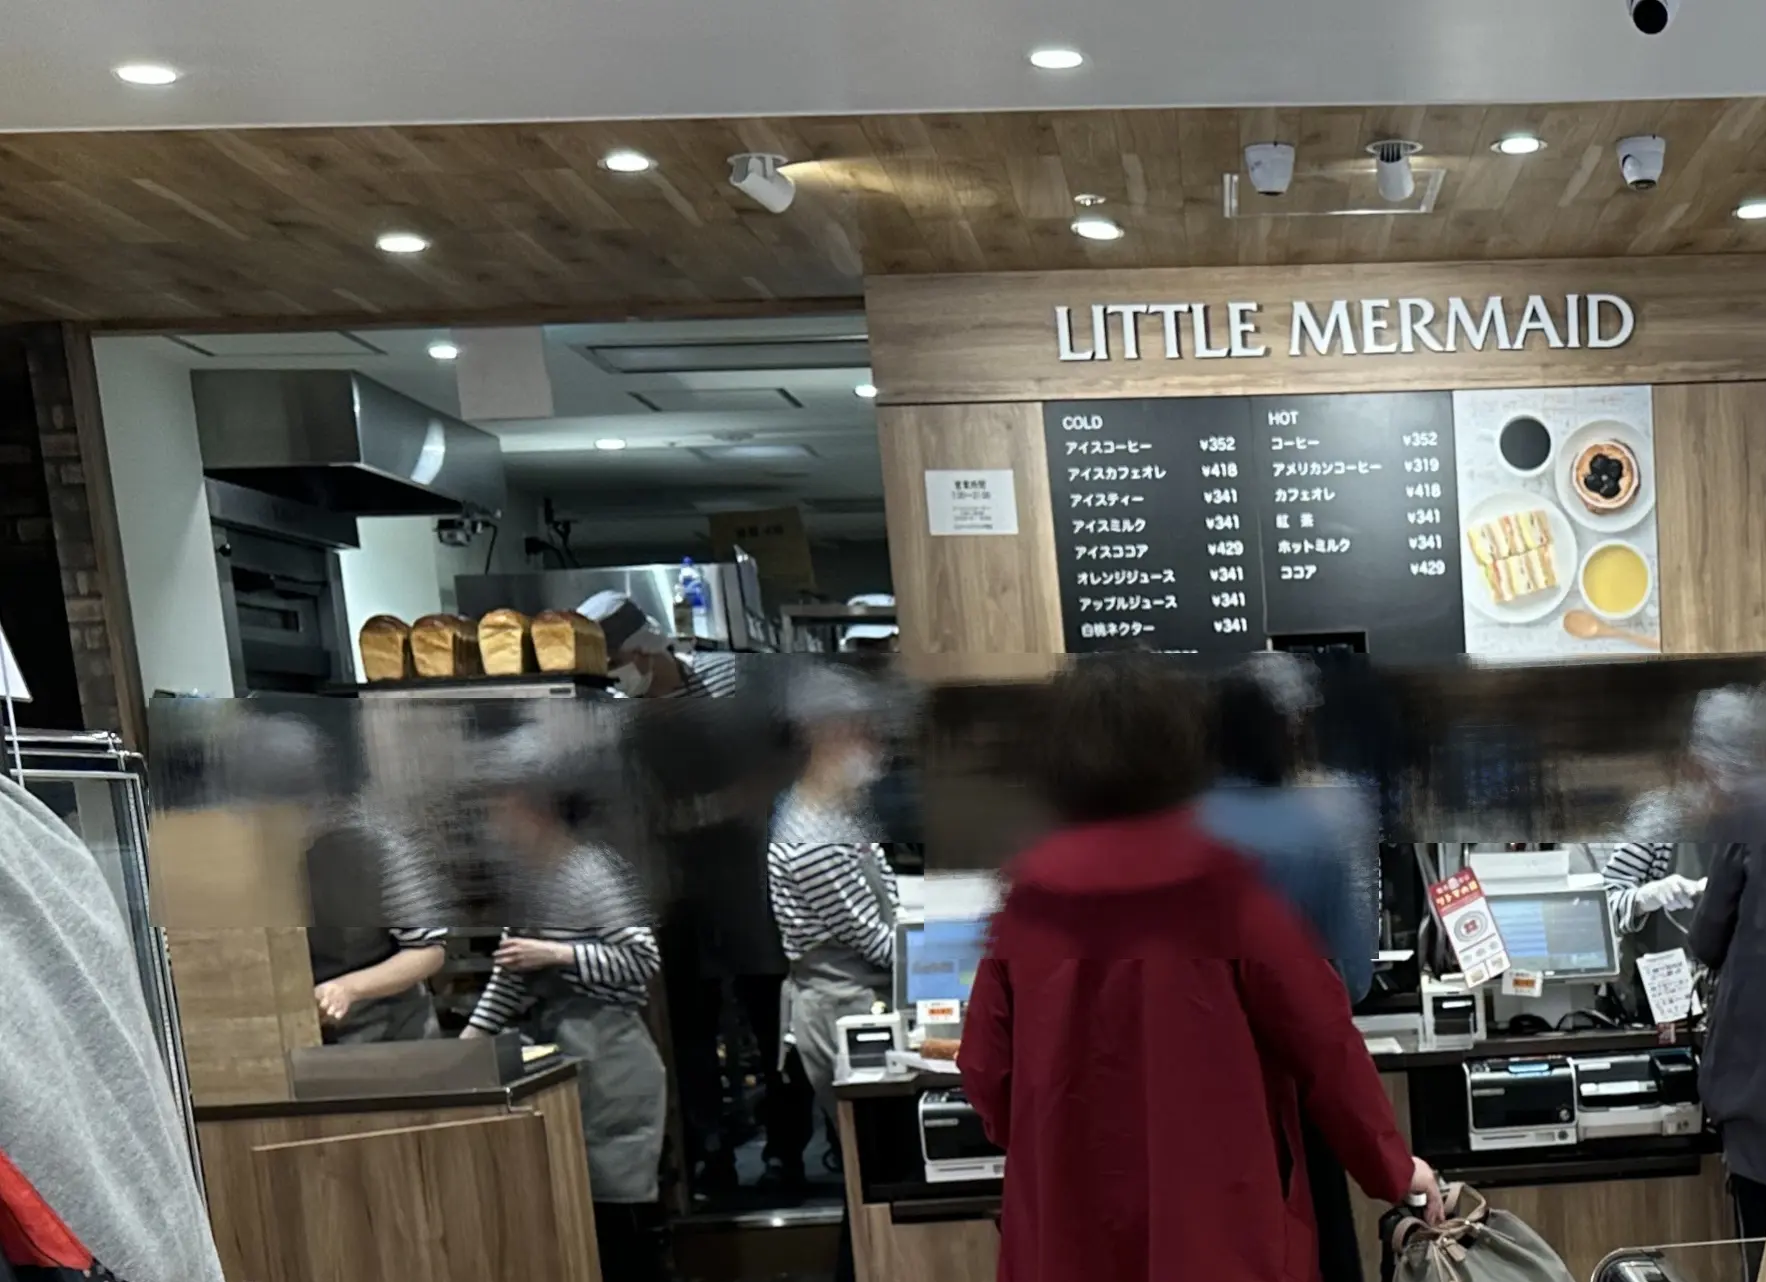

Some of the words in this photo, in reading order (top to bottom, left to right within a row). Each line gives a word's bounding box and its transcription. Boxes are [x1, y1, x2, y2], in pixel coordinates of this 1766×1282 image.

[1055, 301, 1267, 361] LITTLE
[1289, 293, 1635, 356] MERMAID
[1062, 415, 1103, 430] COLD
[1267, 411, 1299, 426] HOT
[1065, 439, 1152, 455] アイスコーヒー
[1200, 436, 1236, 452] ¥352
[1271, 436, 1320, 450] コーヒー
[1403, 432, 1438, 447] ¥352
[1067, 465, 1167, 481] アイスカフェオレ
[1201, 461, 1238, 477] ¥418
[1272, 460, 1383, 477] アメリカンコーヒー
[1404, 457, 1440, 472] ¥319
[1070, 492, 1145, 508] アイスティー
[1203, 488, 1238, 504] ¥341
[1275, 487, 1335, 502] カフェオレ
[1406, 483, 1441, 498] ¥418
[1072, 518, 1146, 534] アイスミルク
[1205, 514, 1240, 530] ¥341
[1407, 508, 1441, 524] ¥341
[1074, 544, 1149, 560] アイスココア
[1207, 540, 1244, 556] ¥429
[1278, 538, 1350, 553] ホットミルク
[1409, 534, 1442, 549] ¥341
[1076, 569, 1176, 586] オレンジジュース
[1209, 565, 1244, 582] ¥341
[1281, 564, 1317, 580] ココア
[1410, 560, 1446, 576] ¥429
[1078, 595, 1178, 611] アップルジュース
[1212, 592, 1246, 608] ¥341
[1213, 618, 1248, 633] ¥341
